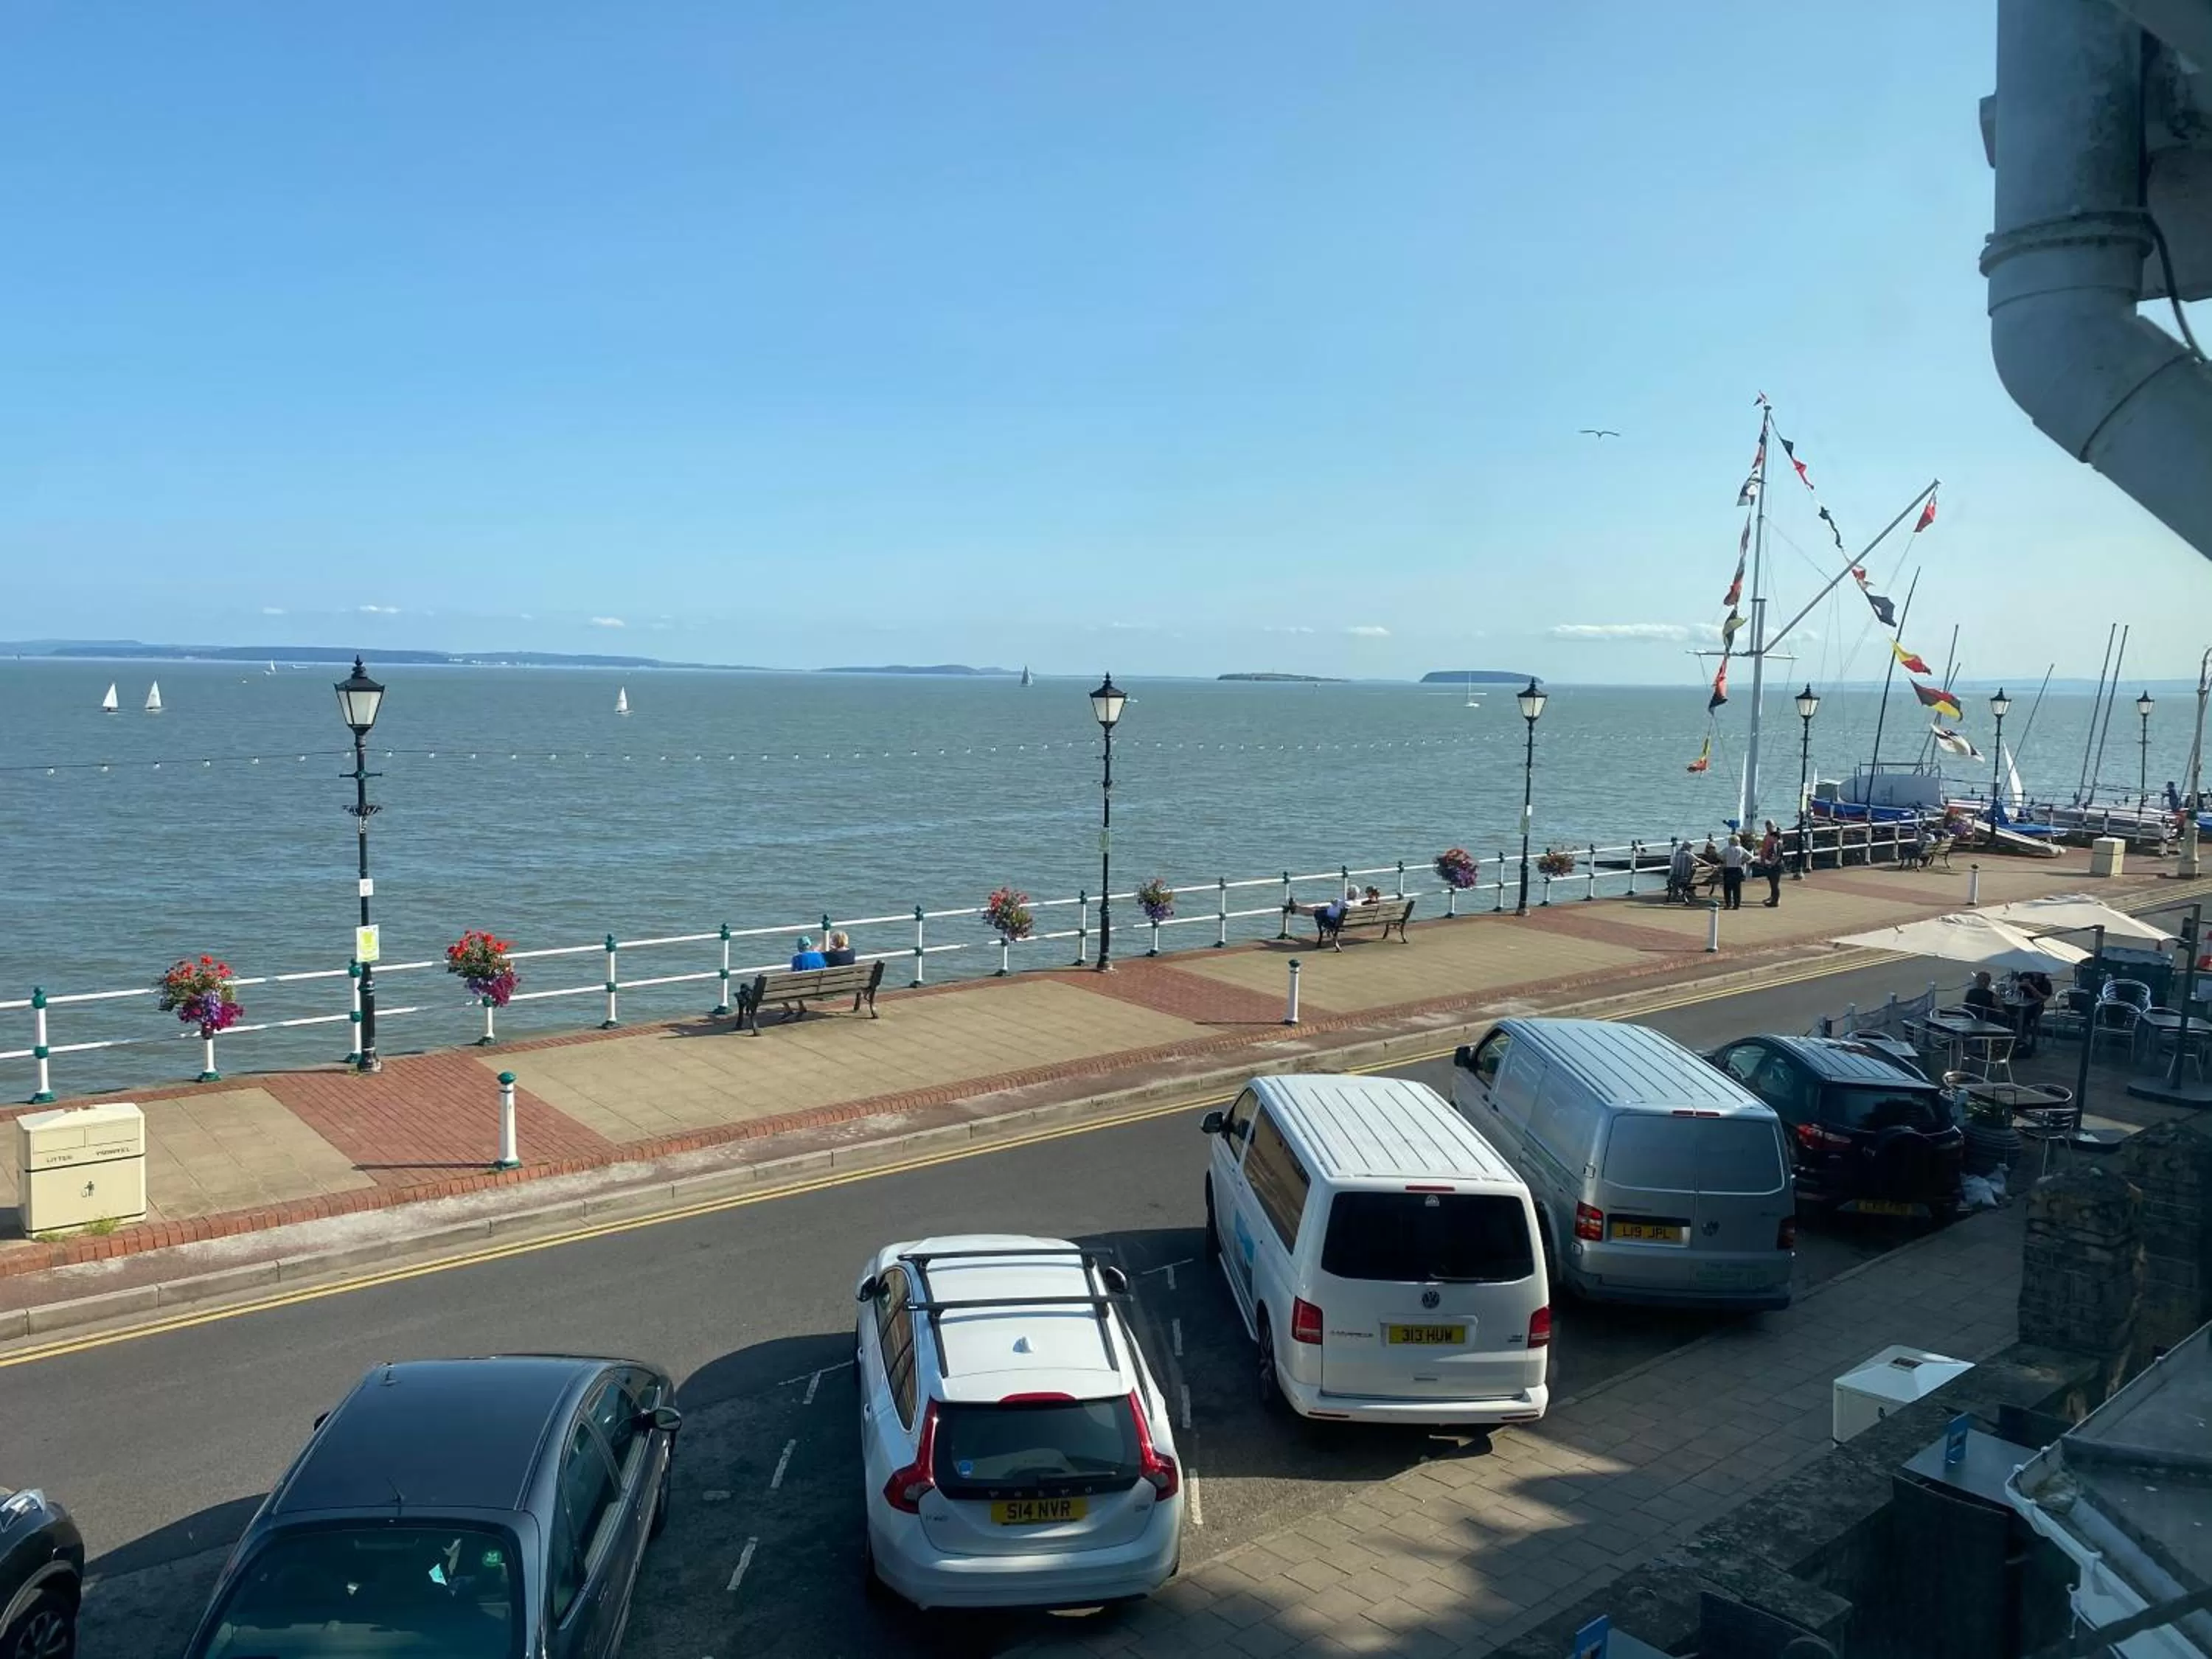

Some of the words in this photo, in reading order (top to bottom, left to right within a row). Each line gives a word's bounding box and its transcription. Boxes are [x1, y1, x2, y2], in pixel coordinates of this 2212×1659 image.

[1402, 1329, 1423, 1342] 313
[1426, 1329, 1452, 1342] HUW
[1007, 1503, 1033, 1520] S14
[1037, 1500, 1071, 1518] NVR
